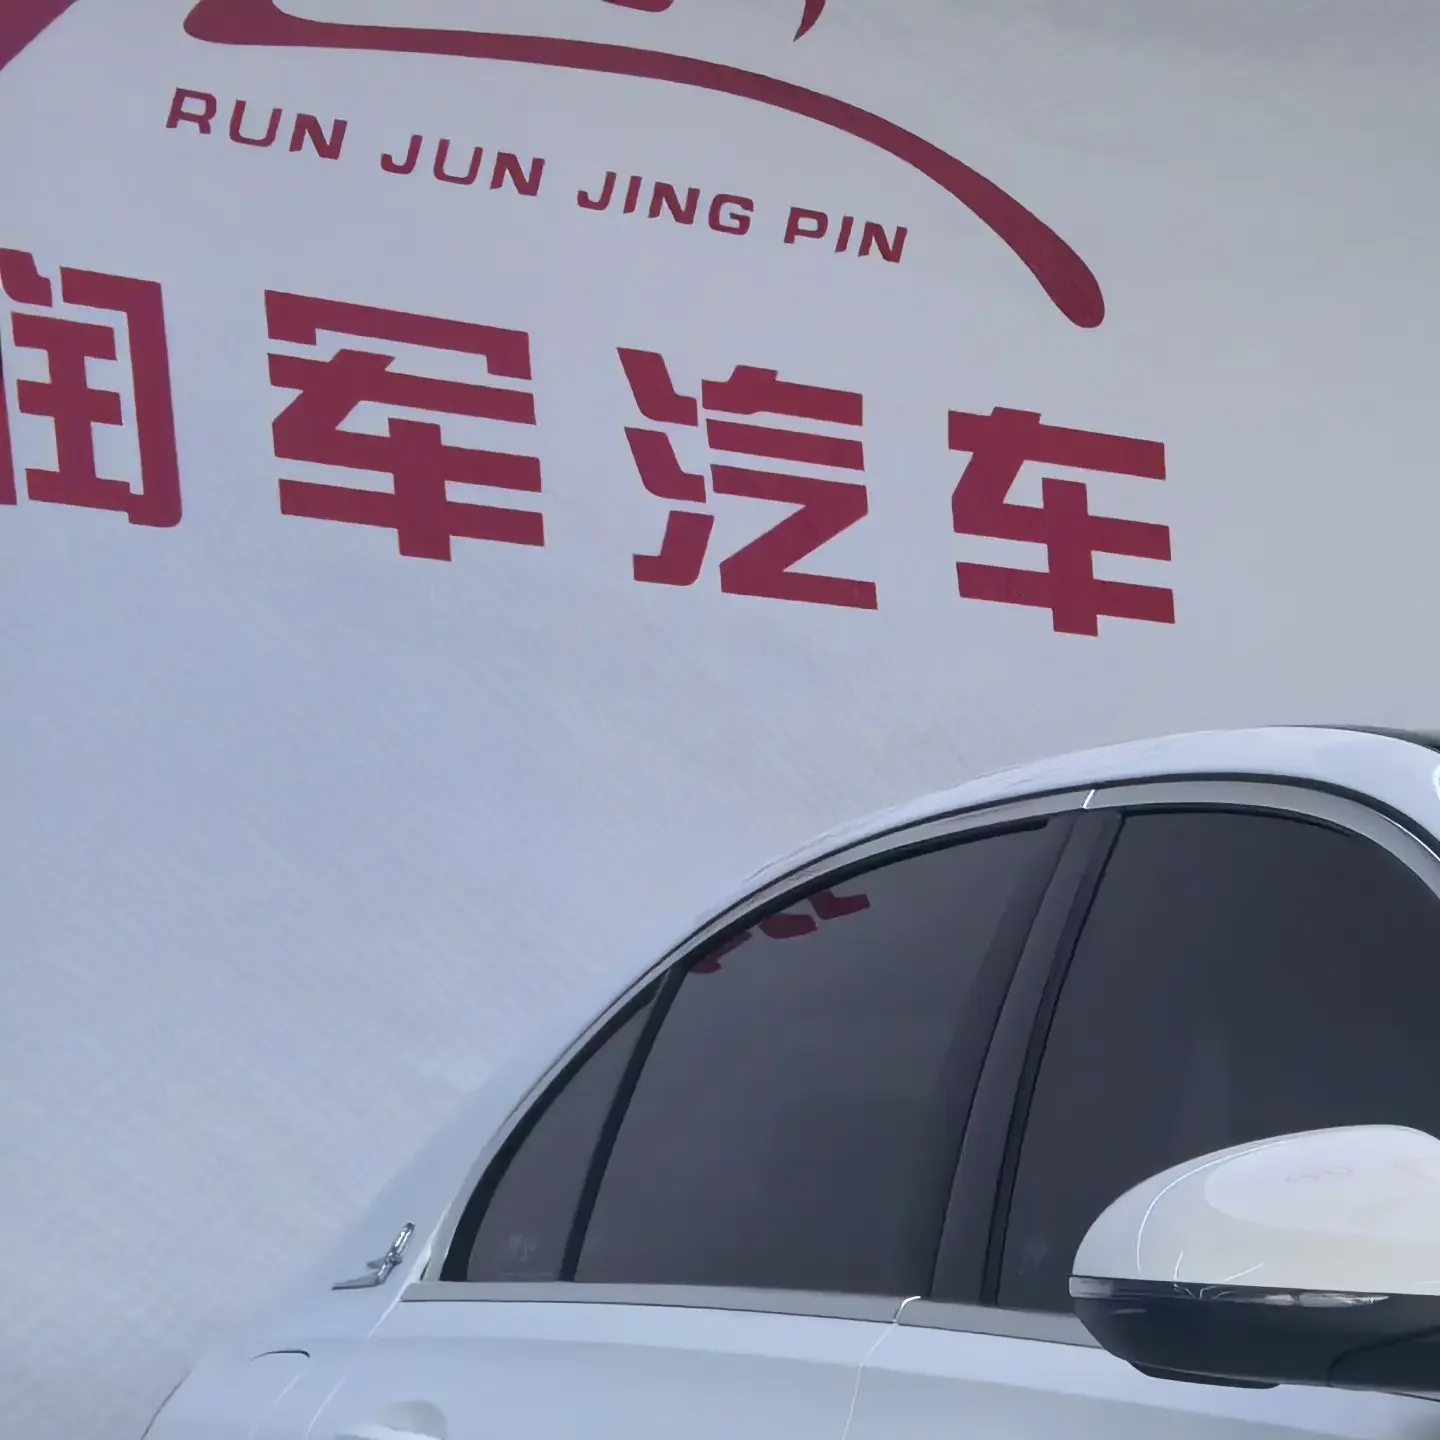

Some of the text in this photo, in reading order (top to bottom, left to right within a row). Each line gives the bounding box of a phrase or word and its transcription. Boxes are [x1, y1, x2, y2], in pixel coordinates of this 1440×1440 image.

[165, 87, 909, 263] RUN JUN JING PIN
